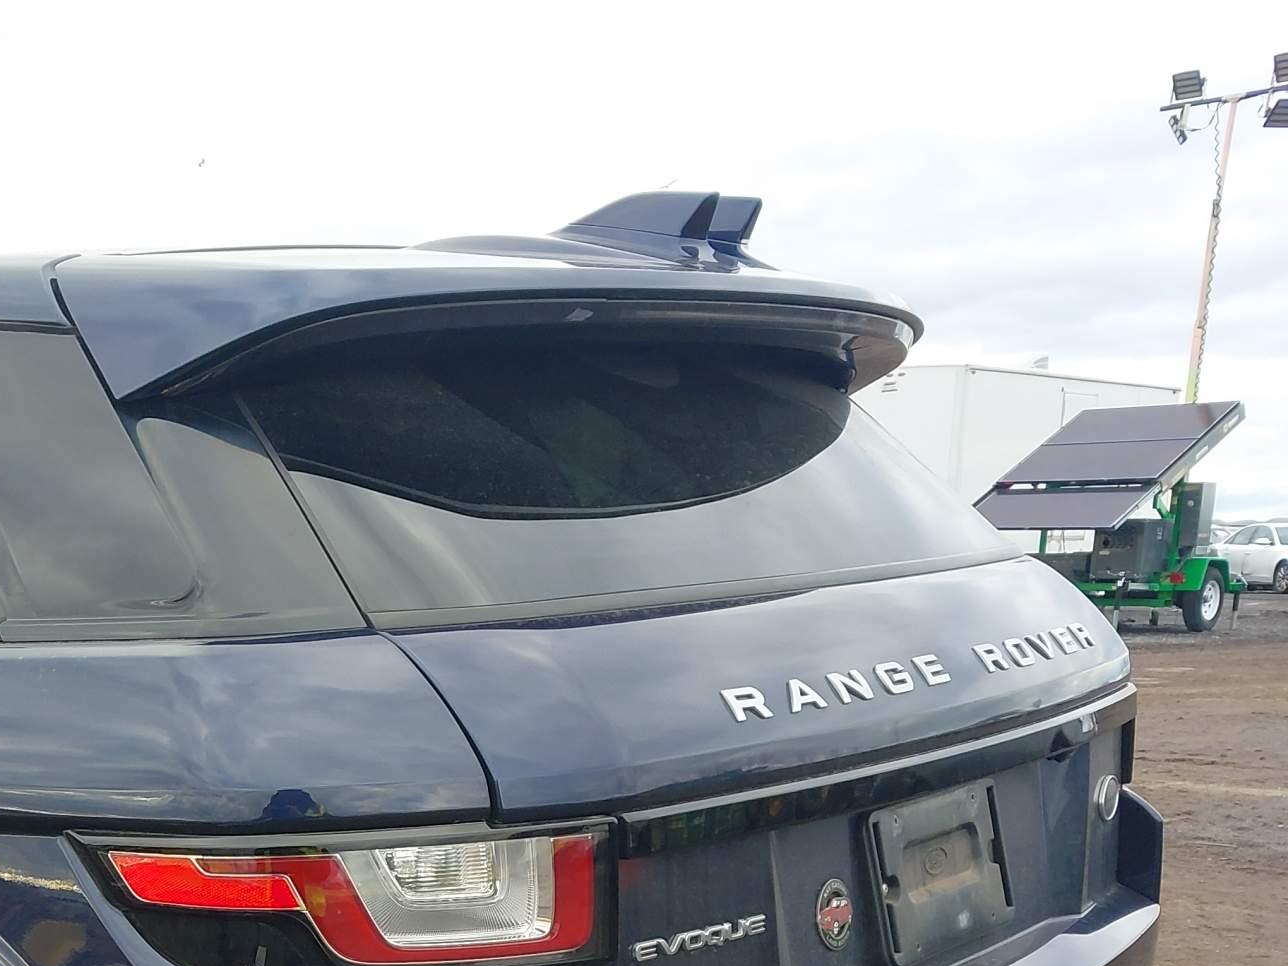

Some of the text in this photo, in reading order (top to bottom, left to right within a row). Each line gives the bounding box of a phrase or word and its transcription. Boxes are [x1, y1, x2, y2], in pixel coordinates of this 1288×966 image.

[720, 622, 1096, 723] RANGE ROVER
[632, 913, 767, 962] EVOQUE
